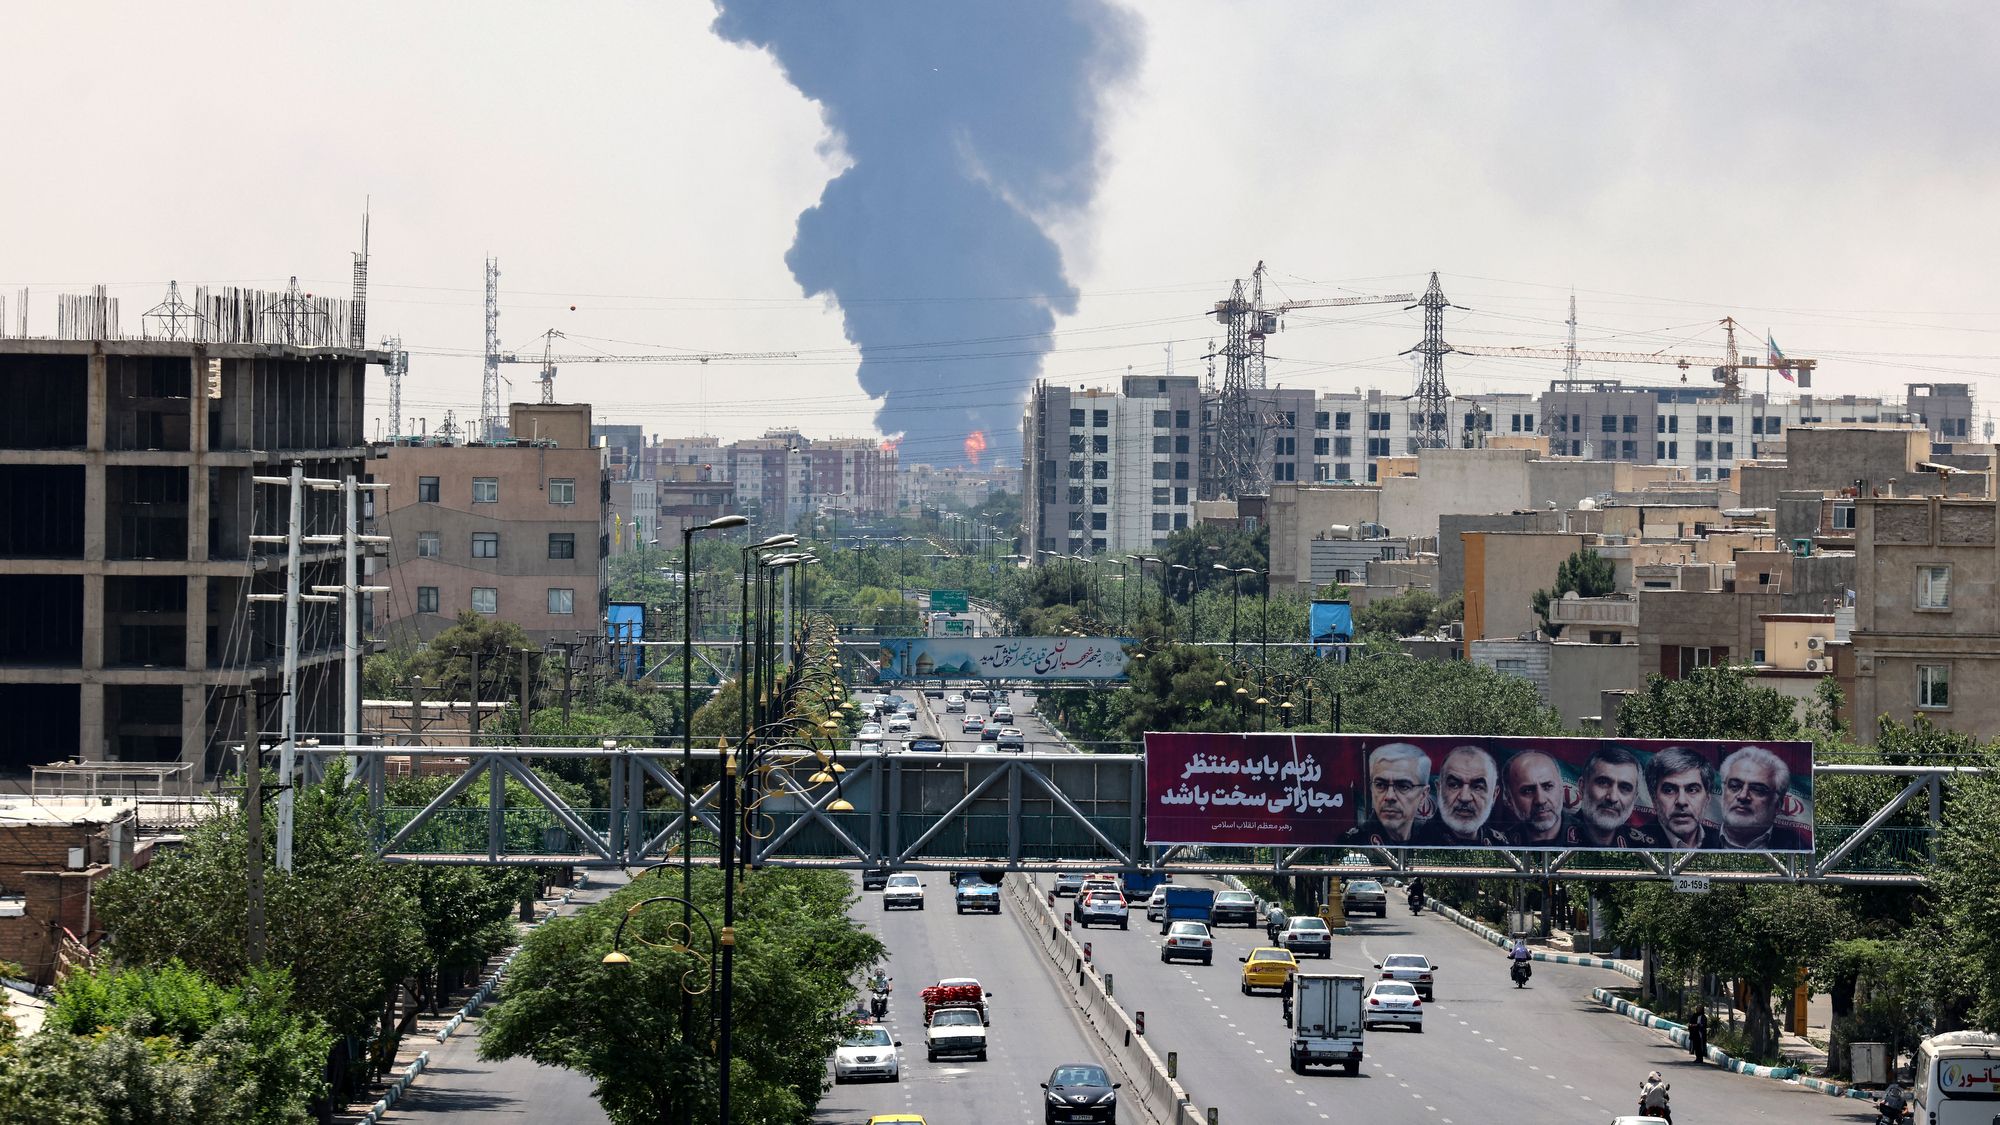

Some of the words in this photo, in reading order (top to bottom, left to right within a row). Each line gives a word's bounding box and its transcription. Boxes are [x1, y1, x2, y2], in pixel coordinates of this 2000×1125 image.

[1180, 752, 1240, 779] منتظر
[1240, 754, 1279, 781] باید
[1280, 753, 1322, 782] رژیم
[1160, 782, 1210, 811] باشد
[1211, 784, 1266, 806] سخت
[1267, 785, 1344, 813] مجازاتی
[1211, 820, 1236, 830] اسلامی
[1236, 821, 1257, 830] انقلاب
[1256, 821, 1278, 831] معظم
[1278, 821, 1293, 832] رهبر
